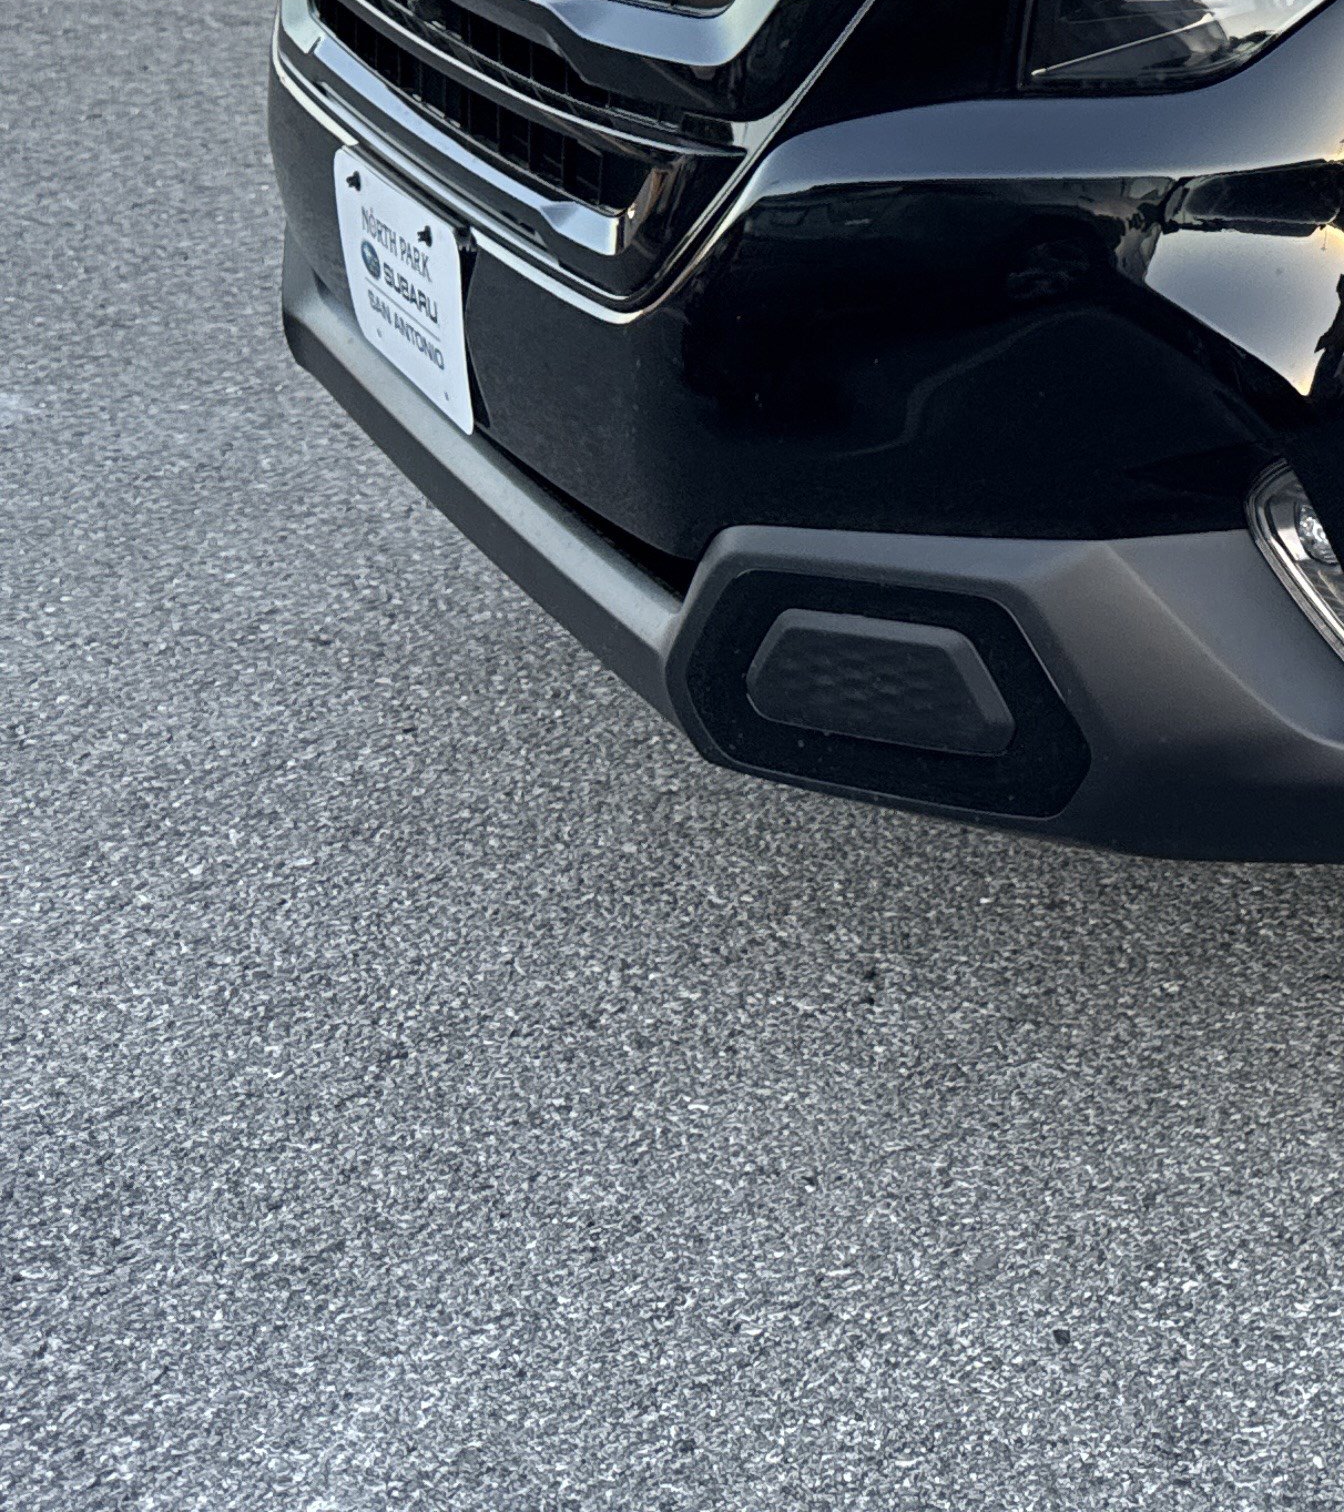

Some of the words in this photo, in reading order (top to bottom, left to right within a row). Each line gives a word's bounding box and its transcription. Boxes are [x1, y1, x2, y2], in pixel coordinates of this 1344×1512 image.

[361, 205, 398, 257] NORTH
[399, 235, 433, 284] PARK
[367, 288, 392, 325] SAN
[393, 311, 445, 371] ANTONIO
[383, 262, 438, 324] SUBARU
